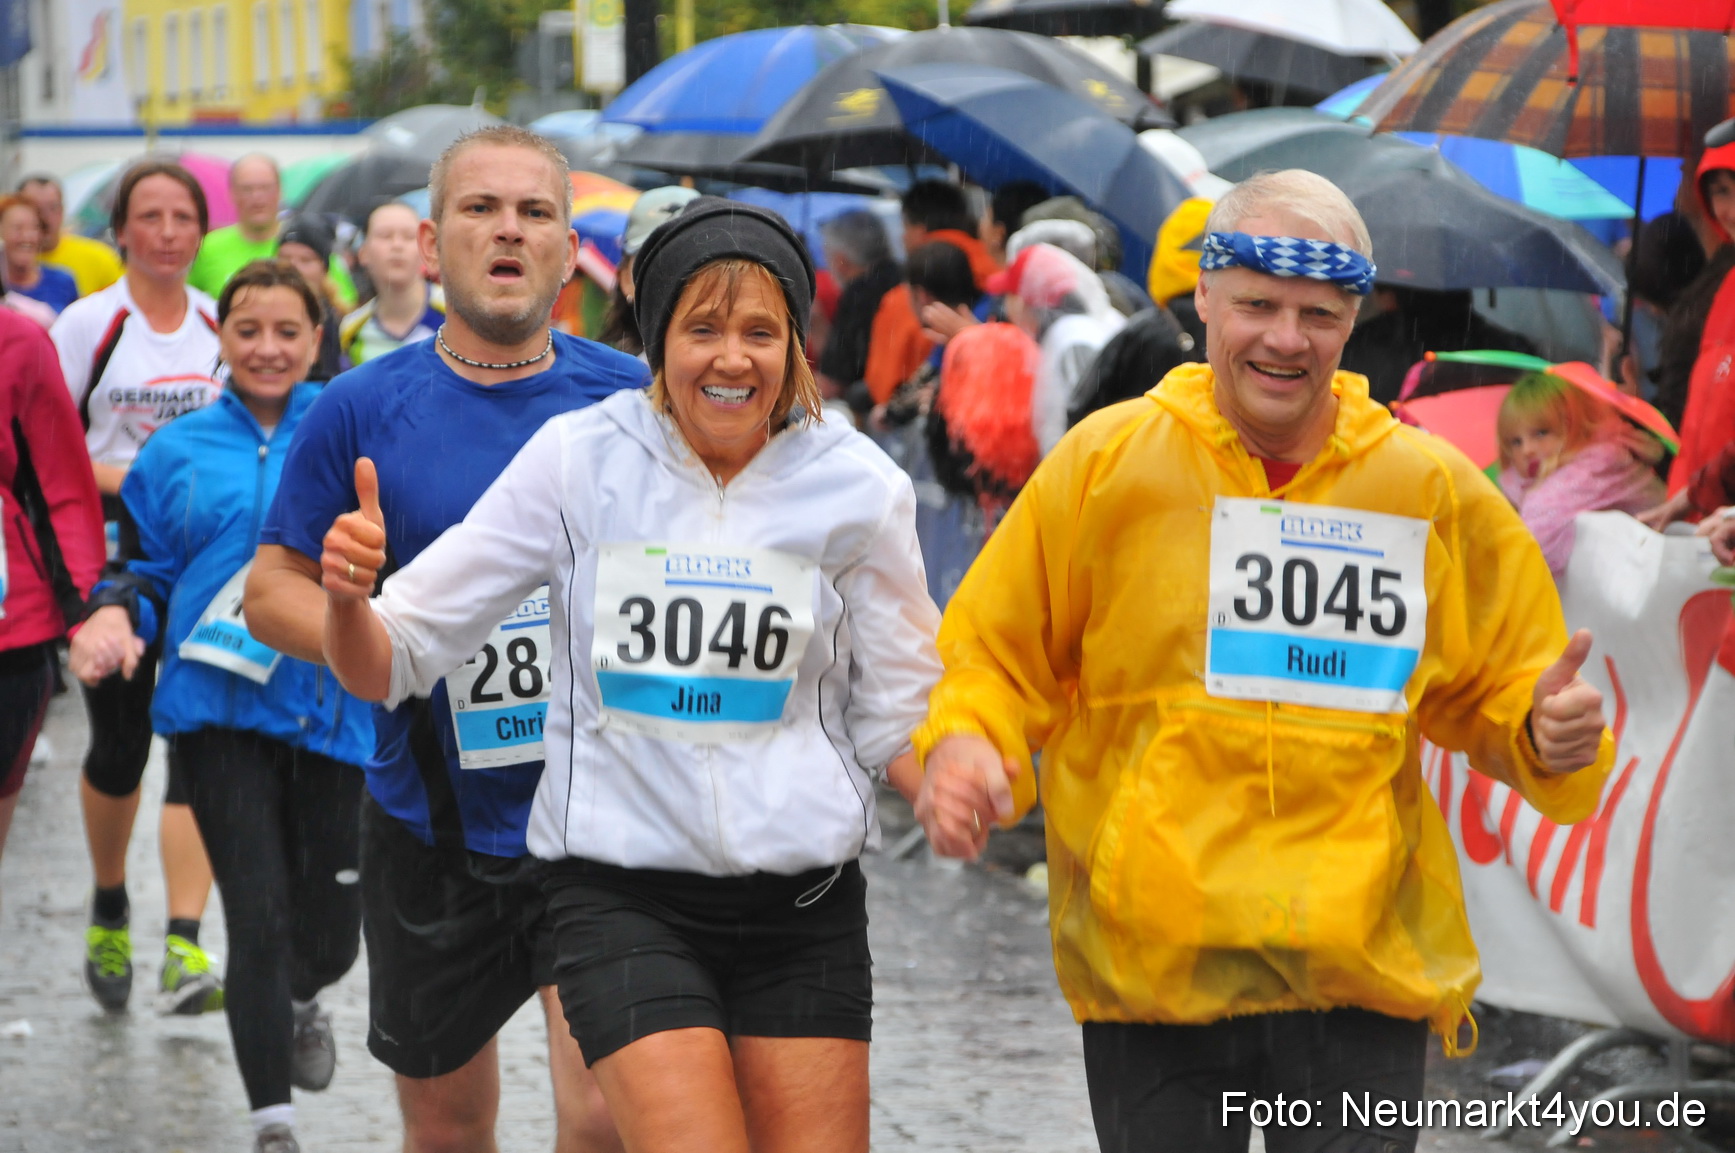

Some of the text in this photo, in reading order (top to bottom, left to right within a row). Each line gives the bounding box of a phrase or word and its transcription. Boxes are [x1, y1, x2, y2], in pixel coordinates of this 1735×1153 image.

[109, 386, 207, 403] GERHART
[1233, 552, 1407, 637] 3045
[617, 595, 793, 671] 3046
[465, 636, 551, 704] 28
[1287, 645, 1347, 678] Rudi
[671, 685, 722, 715] Jina
